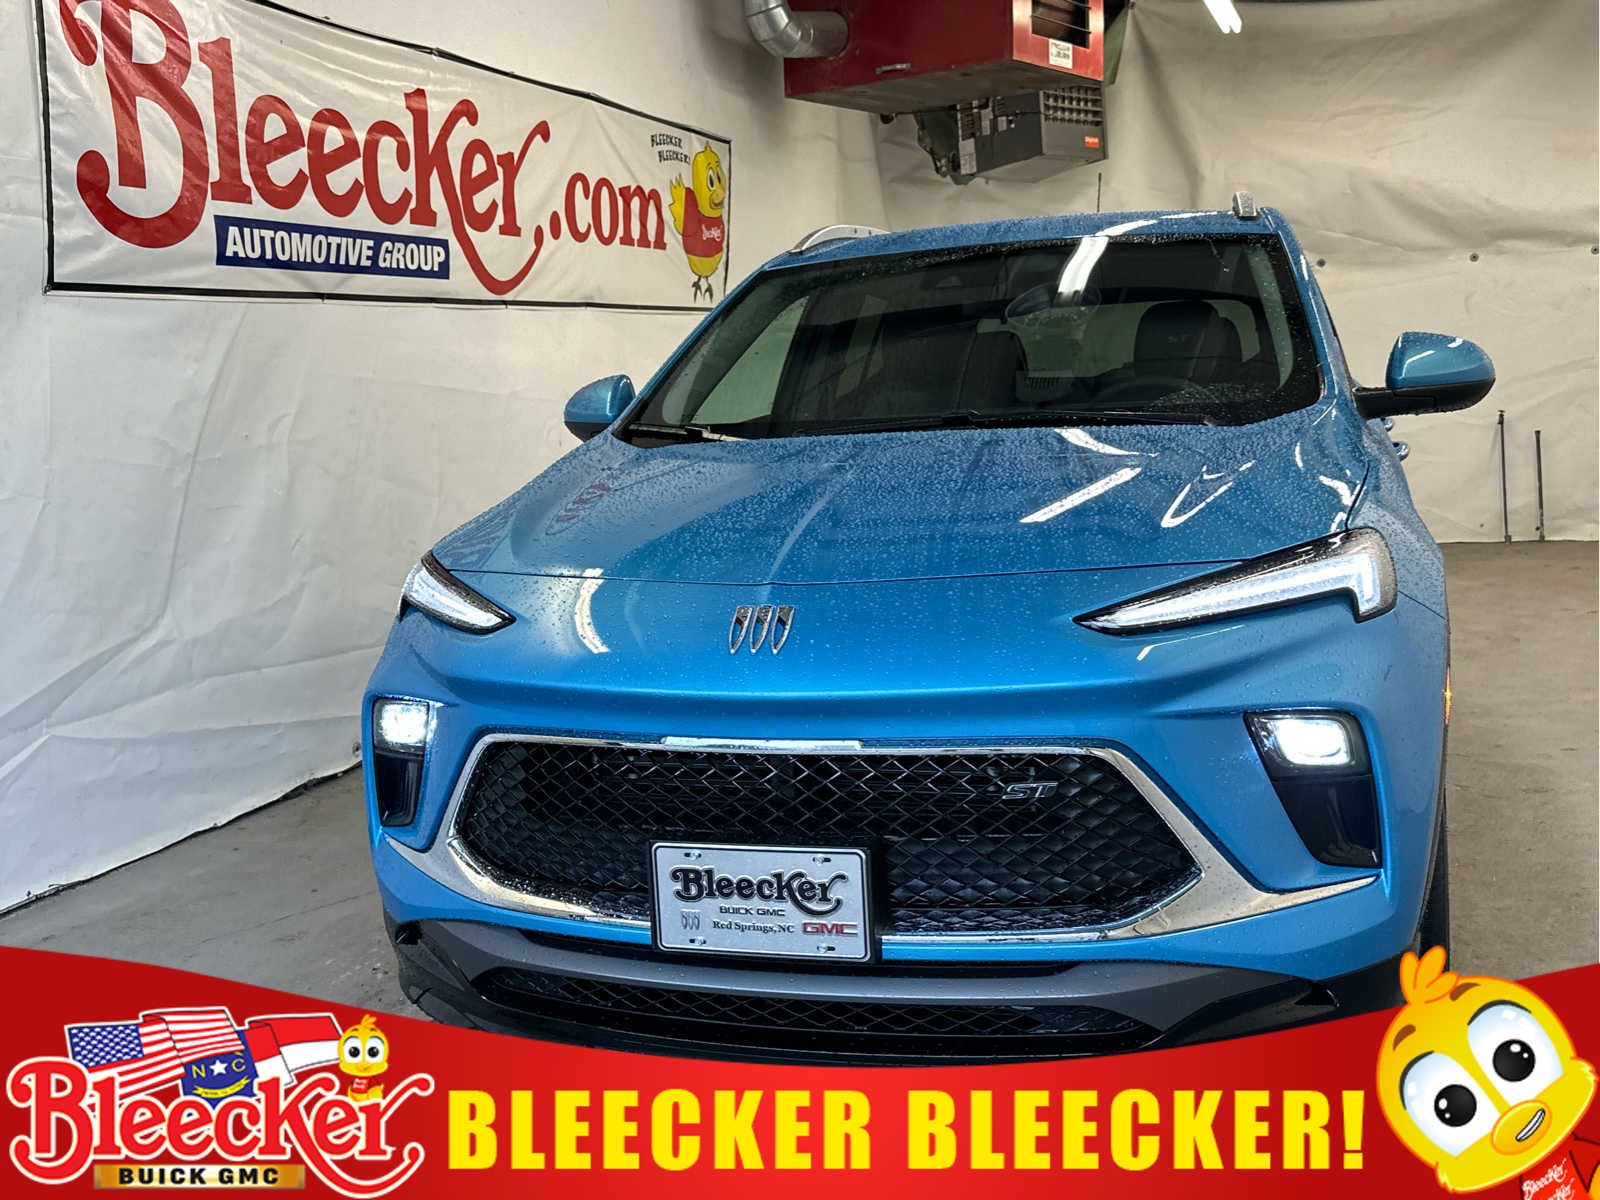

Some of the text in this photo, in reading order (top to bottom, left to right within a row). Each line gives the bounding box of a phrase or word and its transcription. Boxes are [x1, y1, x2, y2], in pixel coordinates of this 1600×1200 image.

[225, 226, 446, 272] AUTOMOTIVE GROUP
[1002, 782, 1058, 799] ST
[719, 905, 786, 917] BUICK GMC
[712, 920, 732, 930] Red
[802, 922, 858, 936] GMC
